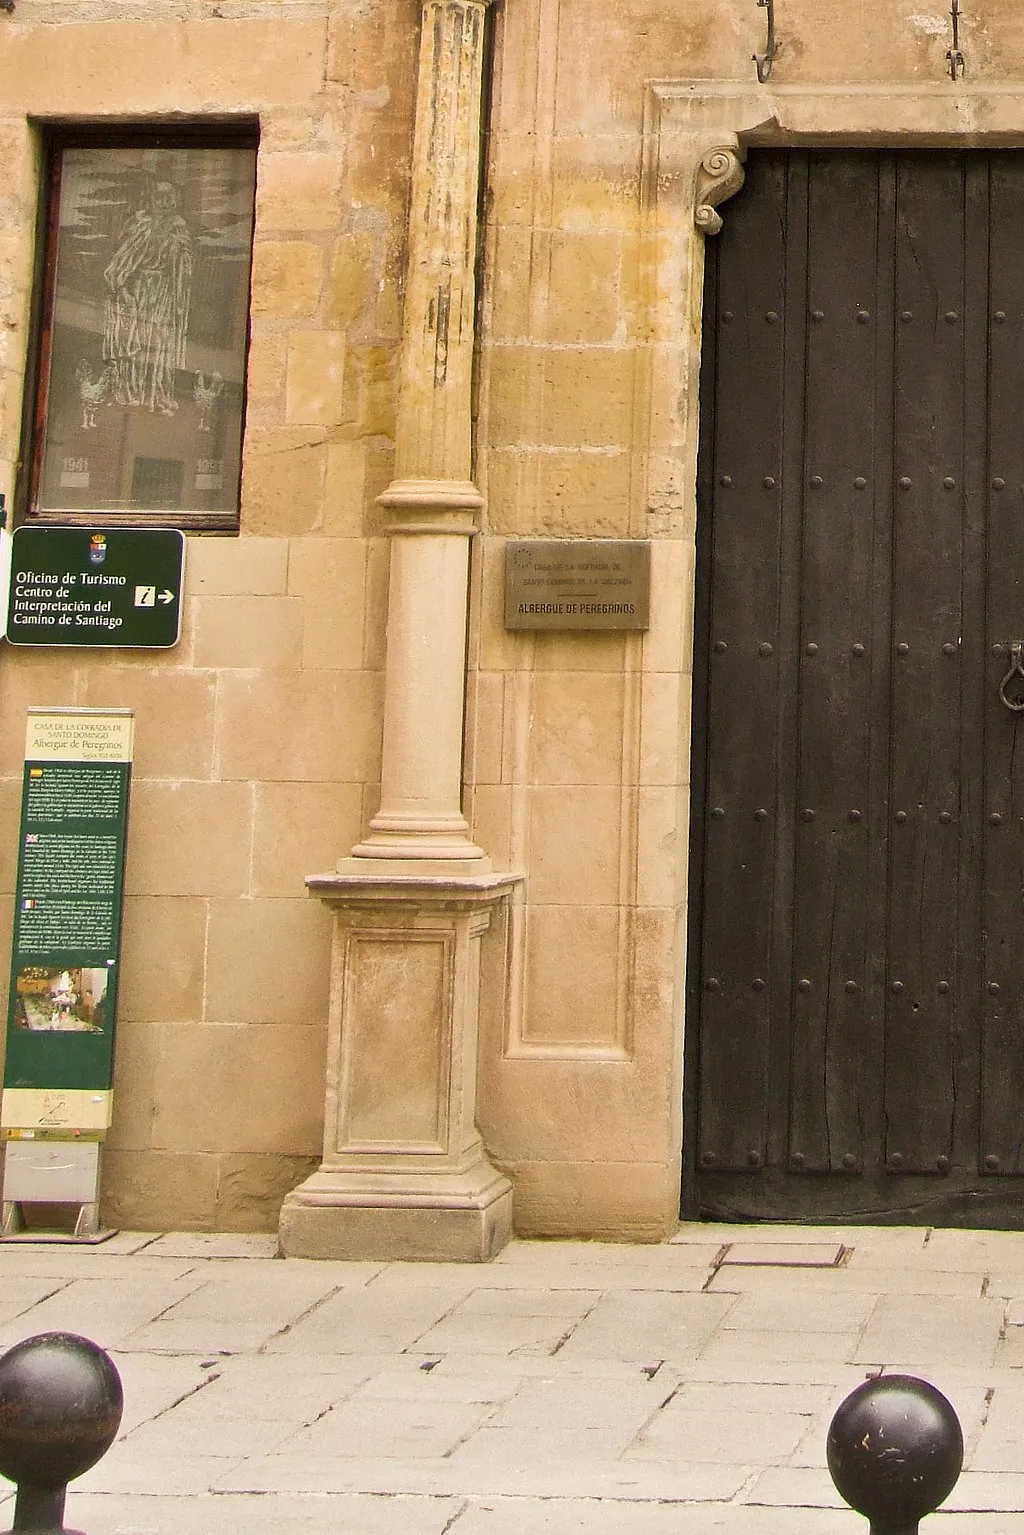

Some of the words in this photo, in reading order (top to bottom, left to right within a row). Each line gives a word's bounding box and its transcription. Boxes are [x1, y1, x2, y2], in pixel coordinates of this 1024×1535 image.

[16, 571, 58, 584] Oficina
[62, 572, 76, 584] de
[80, 573, 127, 586] Turismo
[15, 586, 52, 598] Centro
[56, 587, 70, 598] de
[14, 600, 91, 613] Interpretación
[94, 601, 111, 612] del
[518, 603, 564, 614] ALBERGUE
[566, 603, 578, 614] DE
[580, 603, 635, 614] PEREGRINOS
[13, 614, 55, 625] Camino
[59, 614, 72, 625] de
[75, 615, 123, 629] Santiago
[33, 739, 68, 750] Albergue
[70, 740, 80, 749] de
[82, 740, 123, 751] Peregrinos
